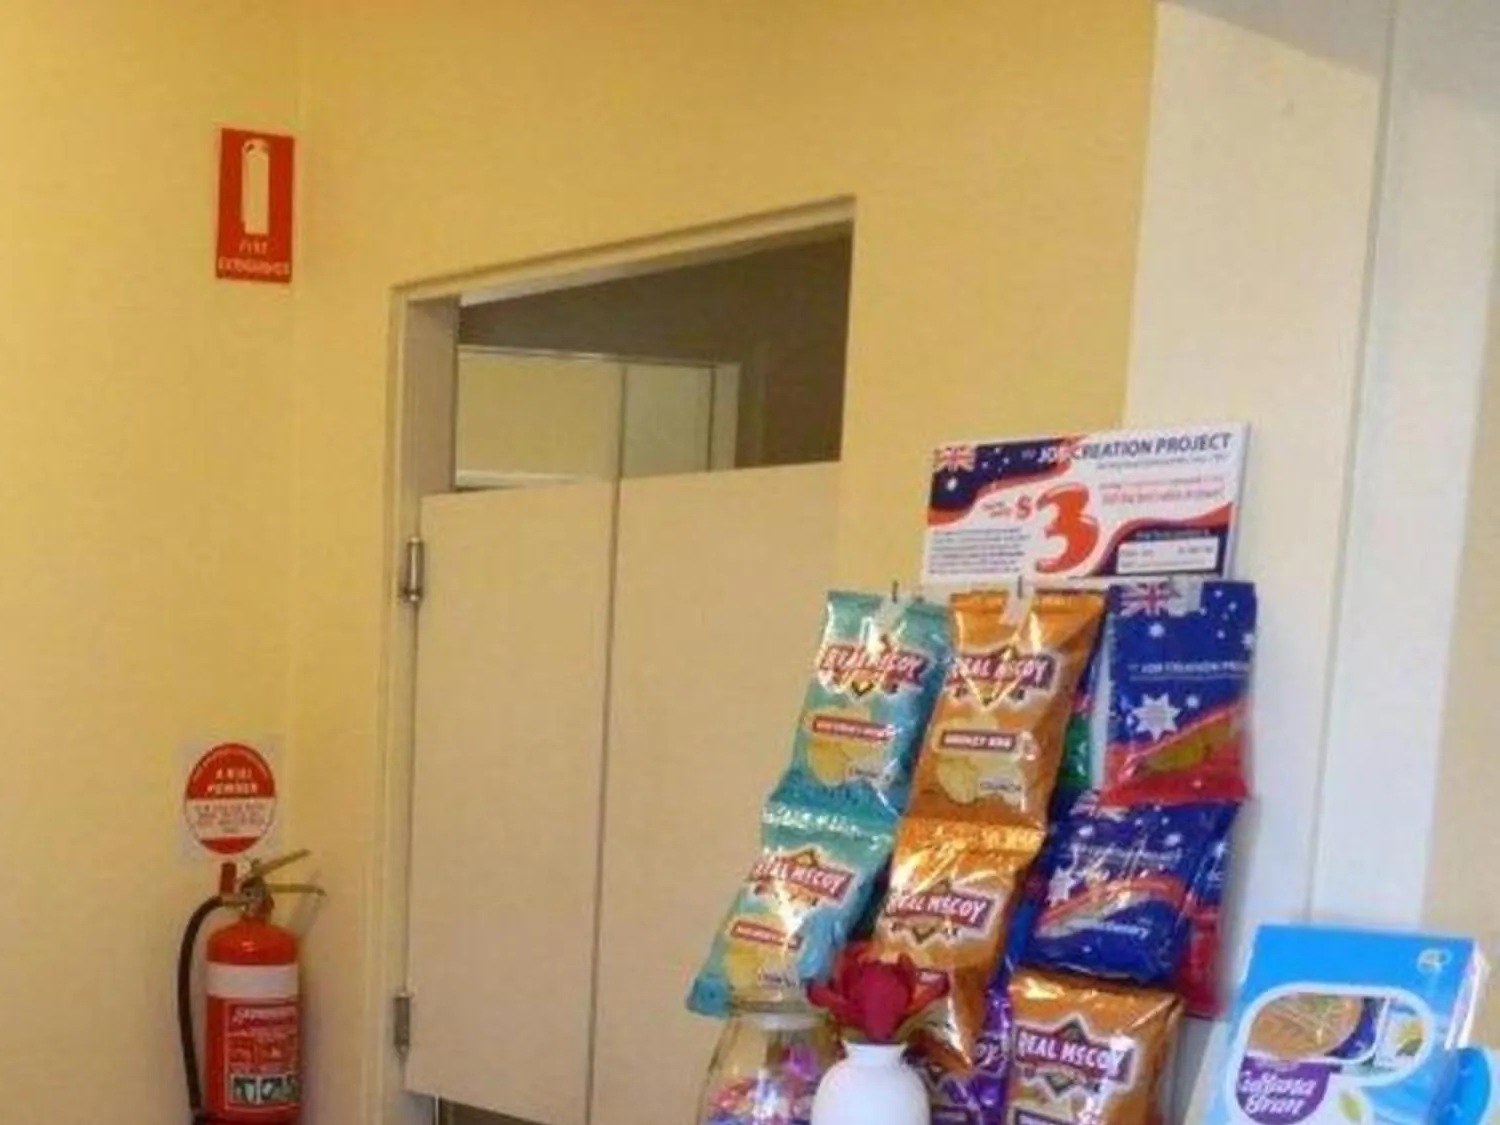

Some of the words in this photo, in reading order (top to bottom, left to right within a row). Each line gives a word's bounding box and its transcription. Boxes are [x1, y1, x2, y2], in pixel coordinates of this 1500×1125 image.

[1071, 437, 1151, 460] CREATION
[1155, 433, 1232, 454] PROJECT
[1018, 1031, 1057, 1059] REAL
